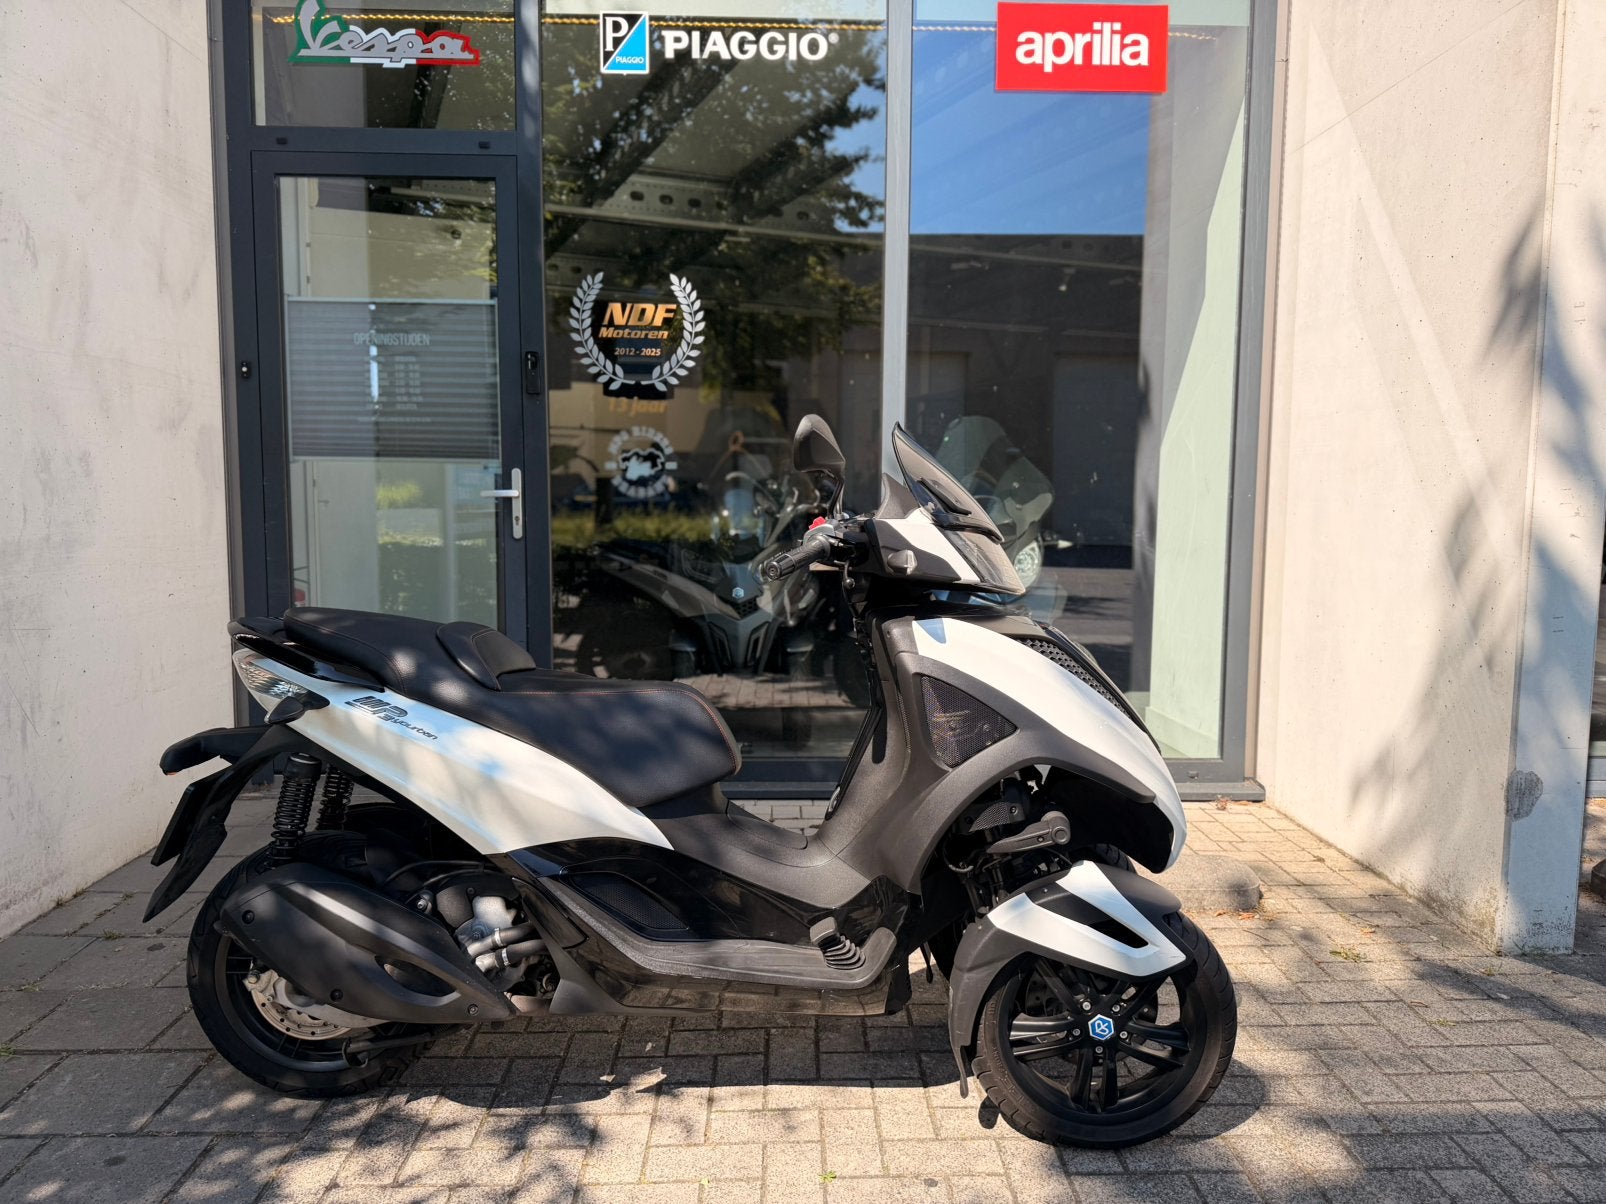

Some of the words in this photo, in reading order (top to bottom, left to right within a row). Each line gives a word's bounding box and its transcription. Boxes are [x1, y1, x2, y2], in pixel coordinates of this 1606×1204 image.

[297, 0, 475, 63] Vespa
[604, 16, 629, 52] P
[1015, 21, 1149, 73] aprilia
[615, 56, 645, 65] PIAGGIO
[602, 302, 677, 327] NDF
[598, 326, 669, 339] Motoren
[614, 347, 635, 356] 2012
[641, 347, 661, 356] 2025
